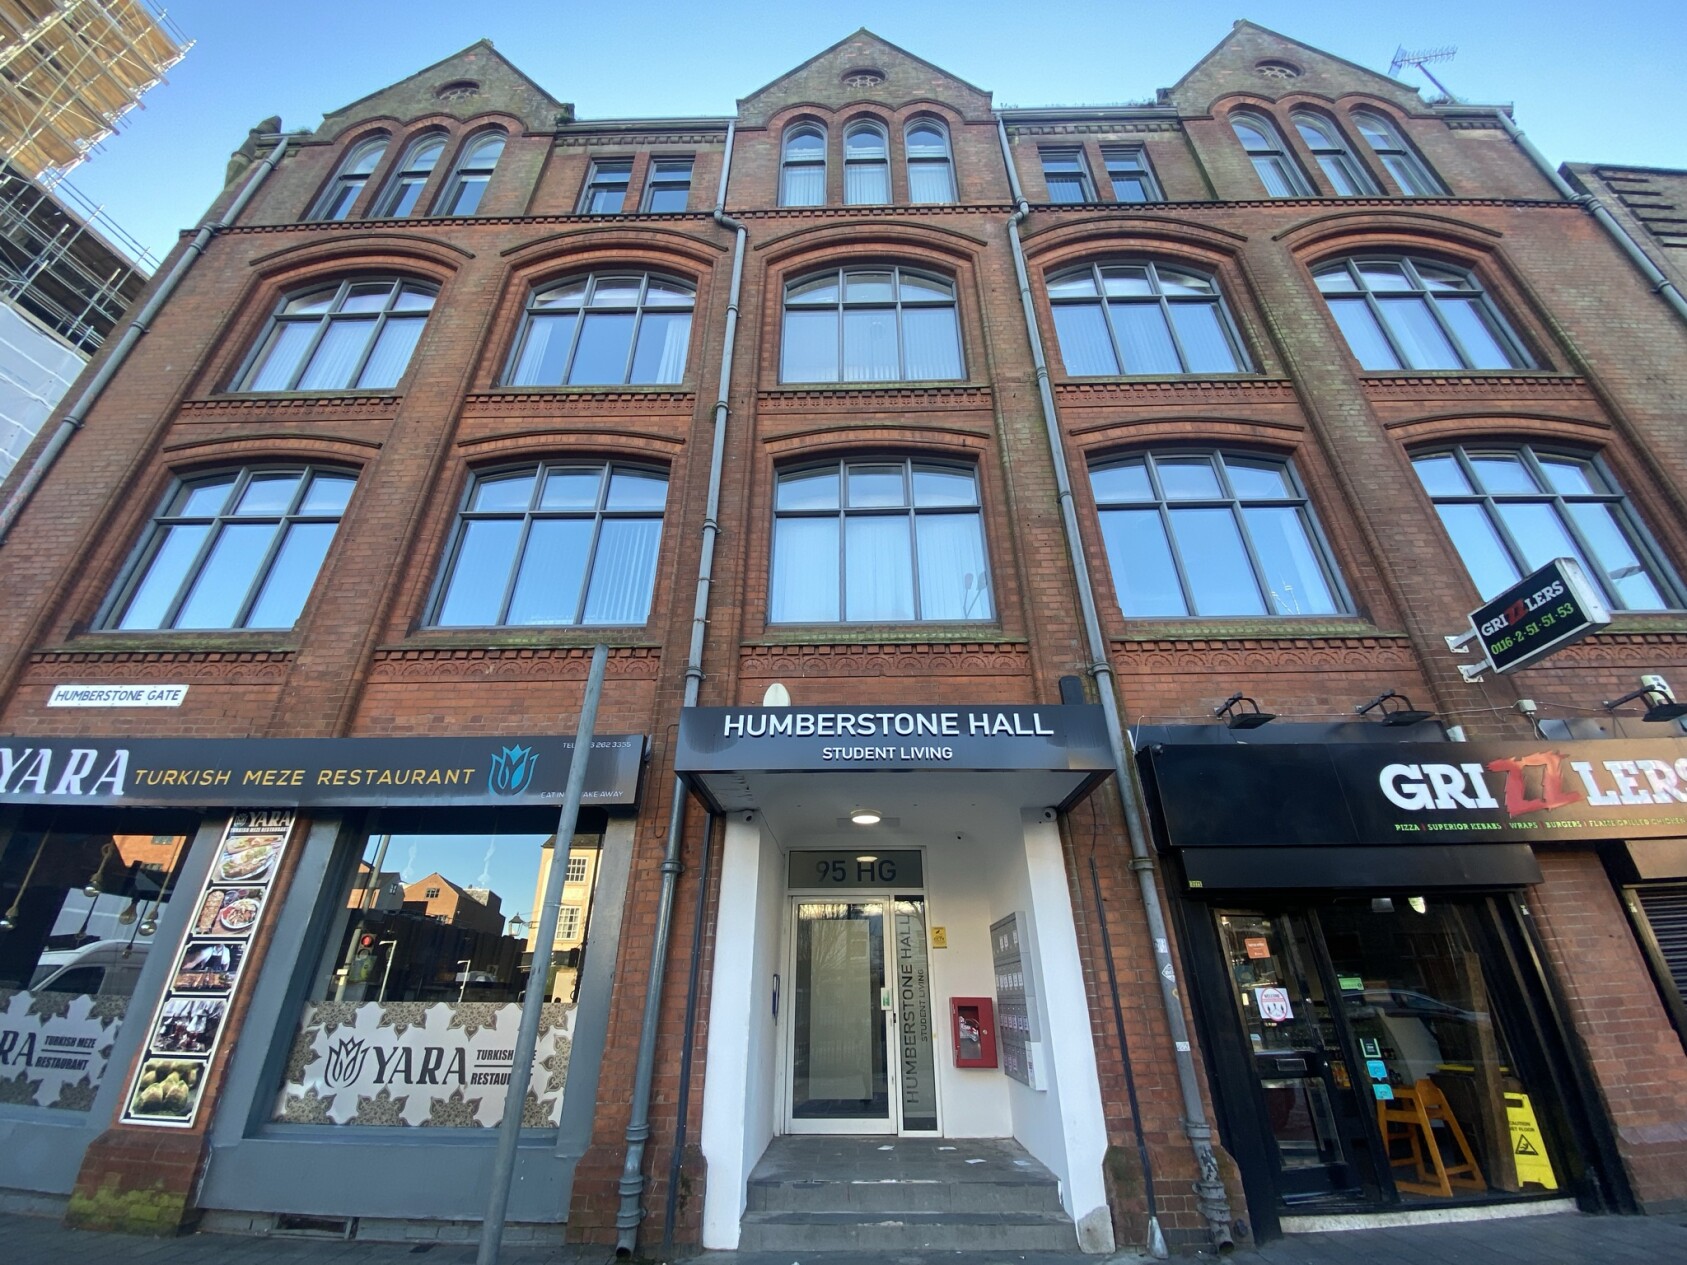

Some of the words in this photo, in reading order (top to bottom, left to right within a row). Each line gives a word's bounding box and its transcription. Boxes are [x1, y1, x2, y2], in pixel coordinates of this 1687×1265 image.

[1481, 580, 1564, 637] GRIZZLERS
[54, 690, 144, 701] HUMBERSTONE
[147, 690, 182, 701] GATE
[723, 713, 960, 737] HUMBERSTONE
[969, 713, 1054, 736] HALL
[822, 746, 897, 760] STUDENT
[900, 746, 954, 760] LIVING
[0, 747, 130, 796] YARA
[135, 769, 231, 786] TURKISH
[243, 770, 306, 786] MEZE
[317, 769, 475, 785] RESTAURANT
[540, 791, 556, 799] EAT
[248, 811, 291, 827] YARA
[1427, 823, 1469, 831] SUPERIOR
[1470, 822, 1502, 830] KEBABS
[1509, 821, 1538, 829] WRAPS
[1545, 820, 1582, 829] BURGERS
[815, 860, 847, 882] 95
[857, 859, 897, 882] HG
[899, 915, 912, 959] HALL
[918, 969, 926, 998] LIVING
[920, 1000, 928, 1042] STUDENT
[45, 1035, 77, 1047] TURKISH
[76, 1037, 97, 1049] MEZE
[901, 964, 919, 1103] HUMBERSTONE
[35, 1056, 89, 1071] RESTAURANT
[476, 1049, 515, 1061] TURKISH
[373, 1046, 467, 1085] YARA
